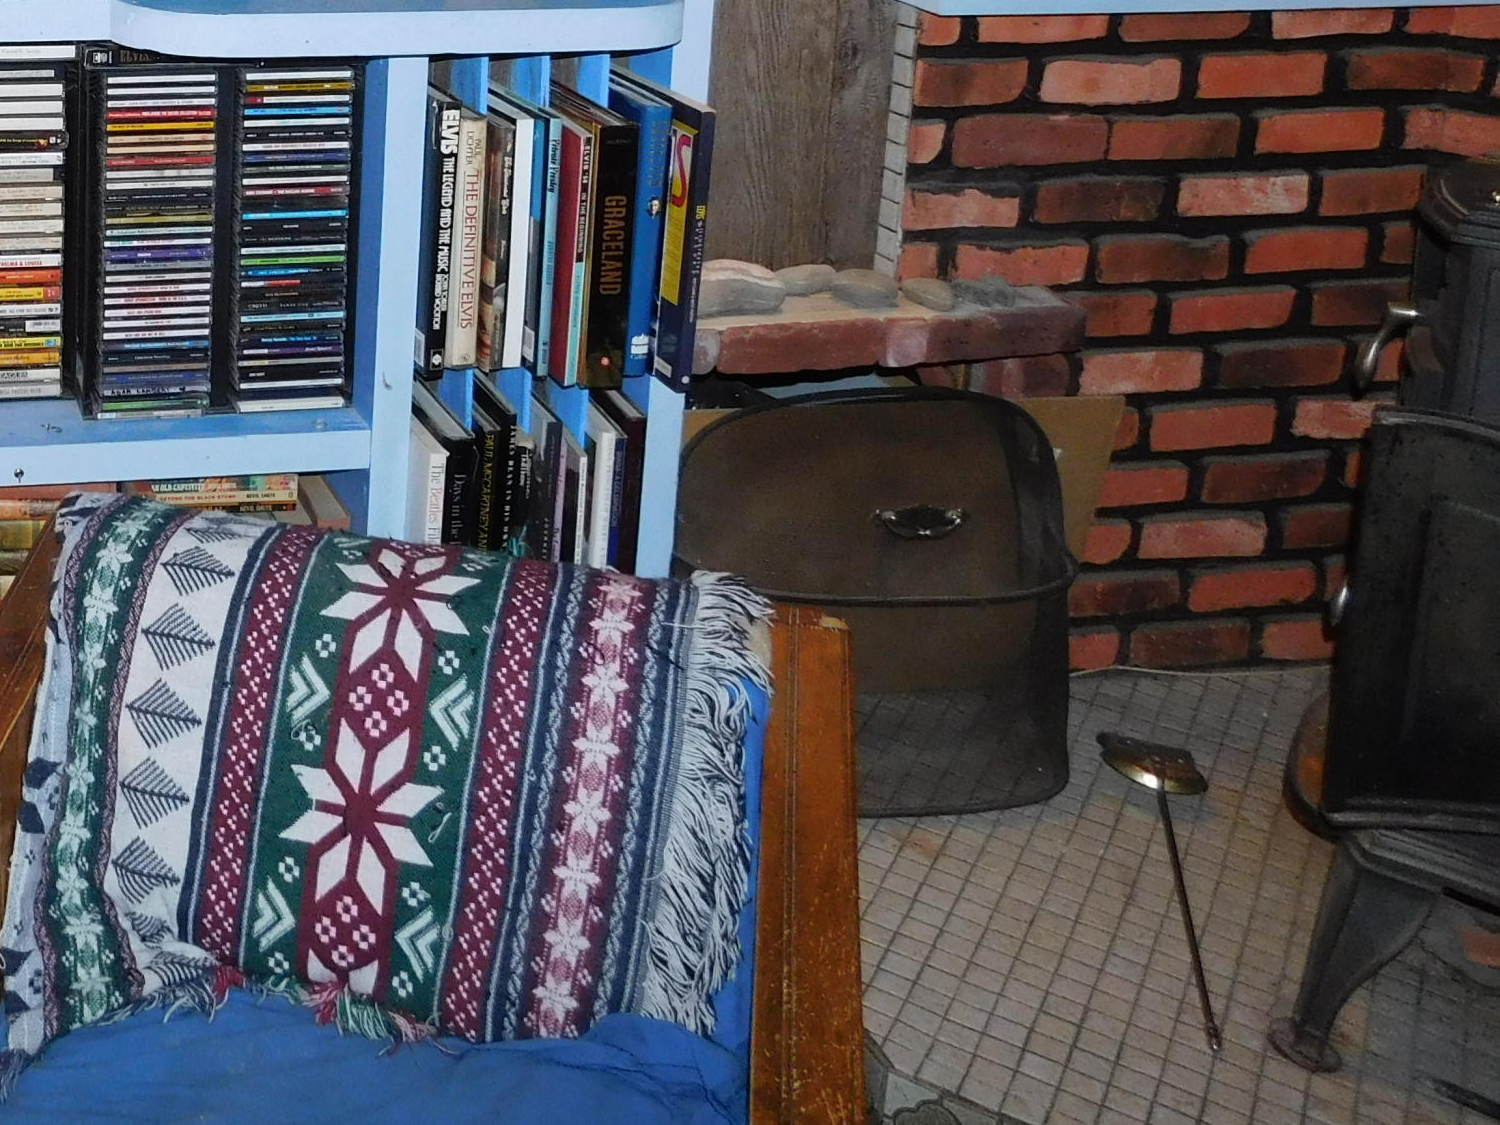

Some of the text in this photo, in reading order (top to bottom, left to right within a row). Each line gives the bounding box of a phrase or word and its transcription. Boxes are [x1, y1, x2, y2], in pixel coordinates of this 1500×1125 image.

[466, 131, 475, 166] LICHTER
[473, 138, 482, 156] PAUL
[582, 145, 590, 170] ELVIS
[436, 109, 460, 272] ELVIS THE LEGEND AND THE MUSIC
[580, 192, 587, 200] IN
[460, 171, 479, 329] THE DEFINITIVE ELVIS
[577, 216, 586, 253] BEGINNING
[599, 195, 627, 295] GRACELAND
[484, 433, 494, 460] PAUL
[427, 463, 444, 523] The Beatles
[448, 474, 467, 537] Days in the
